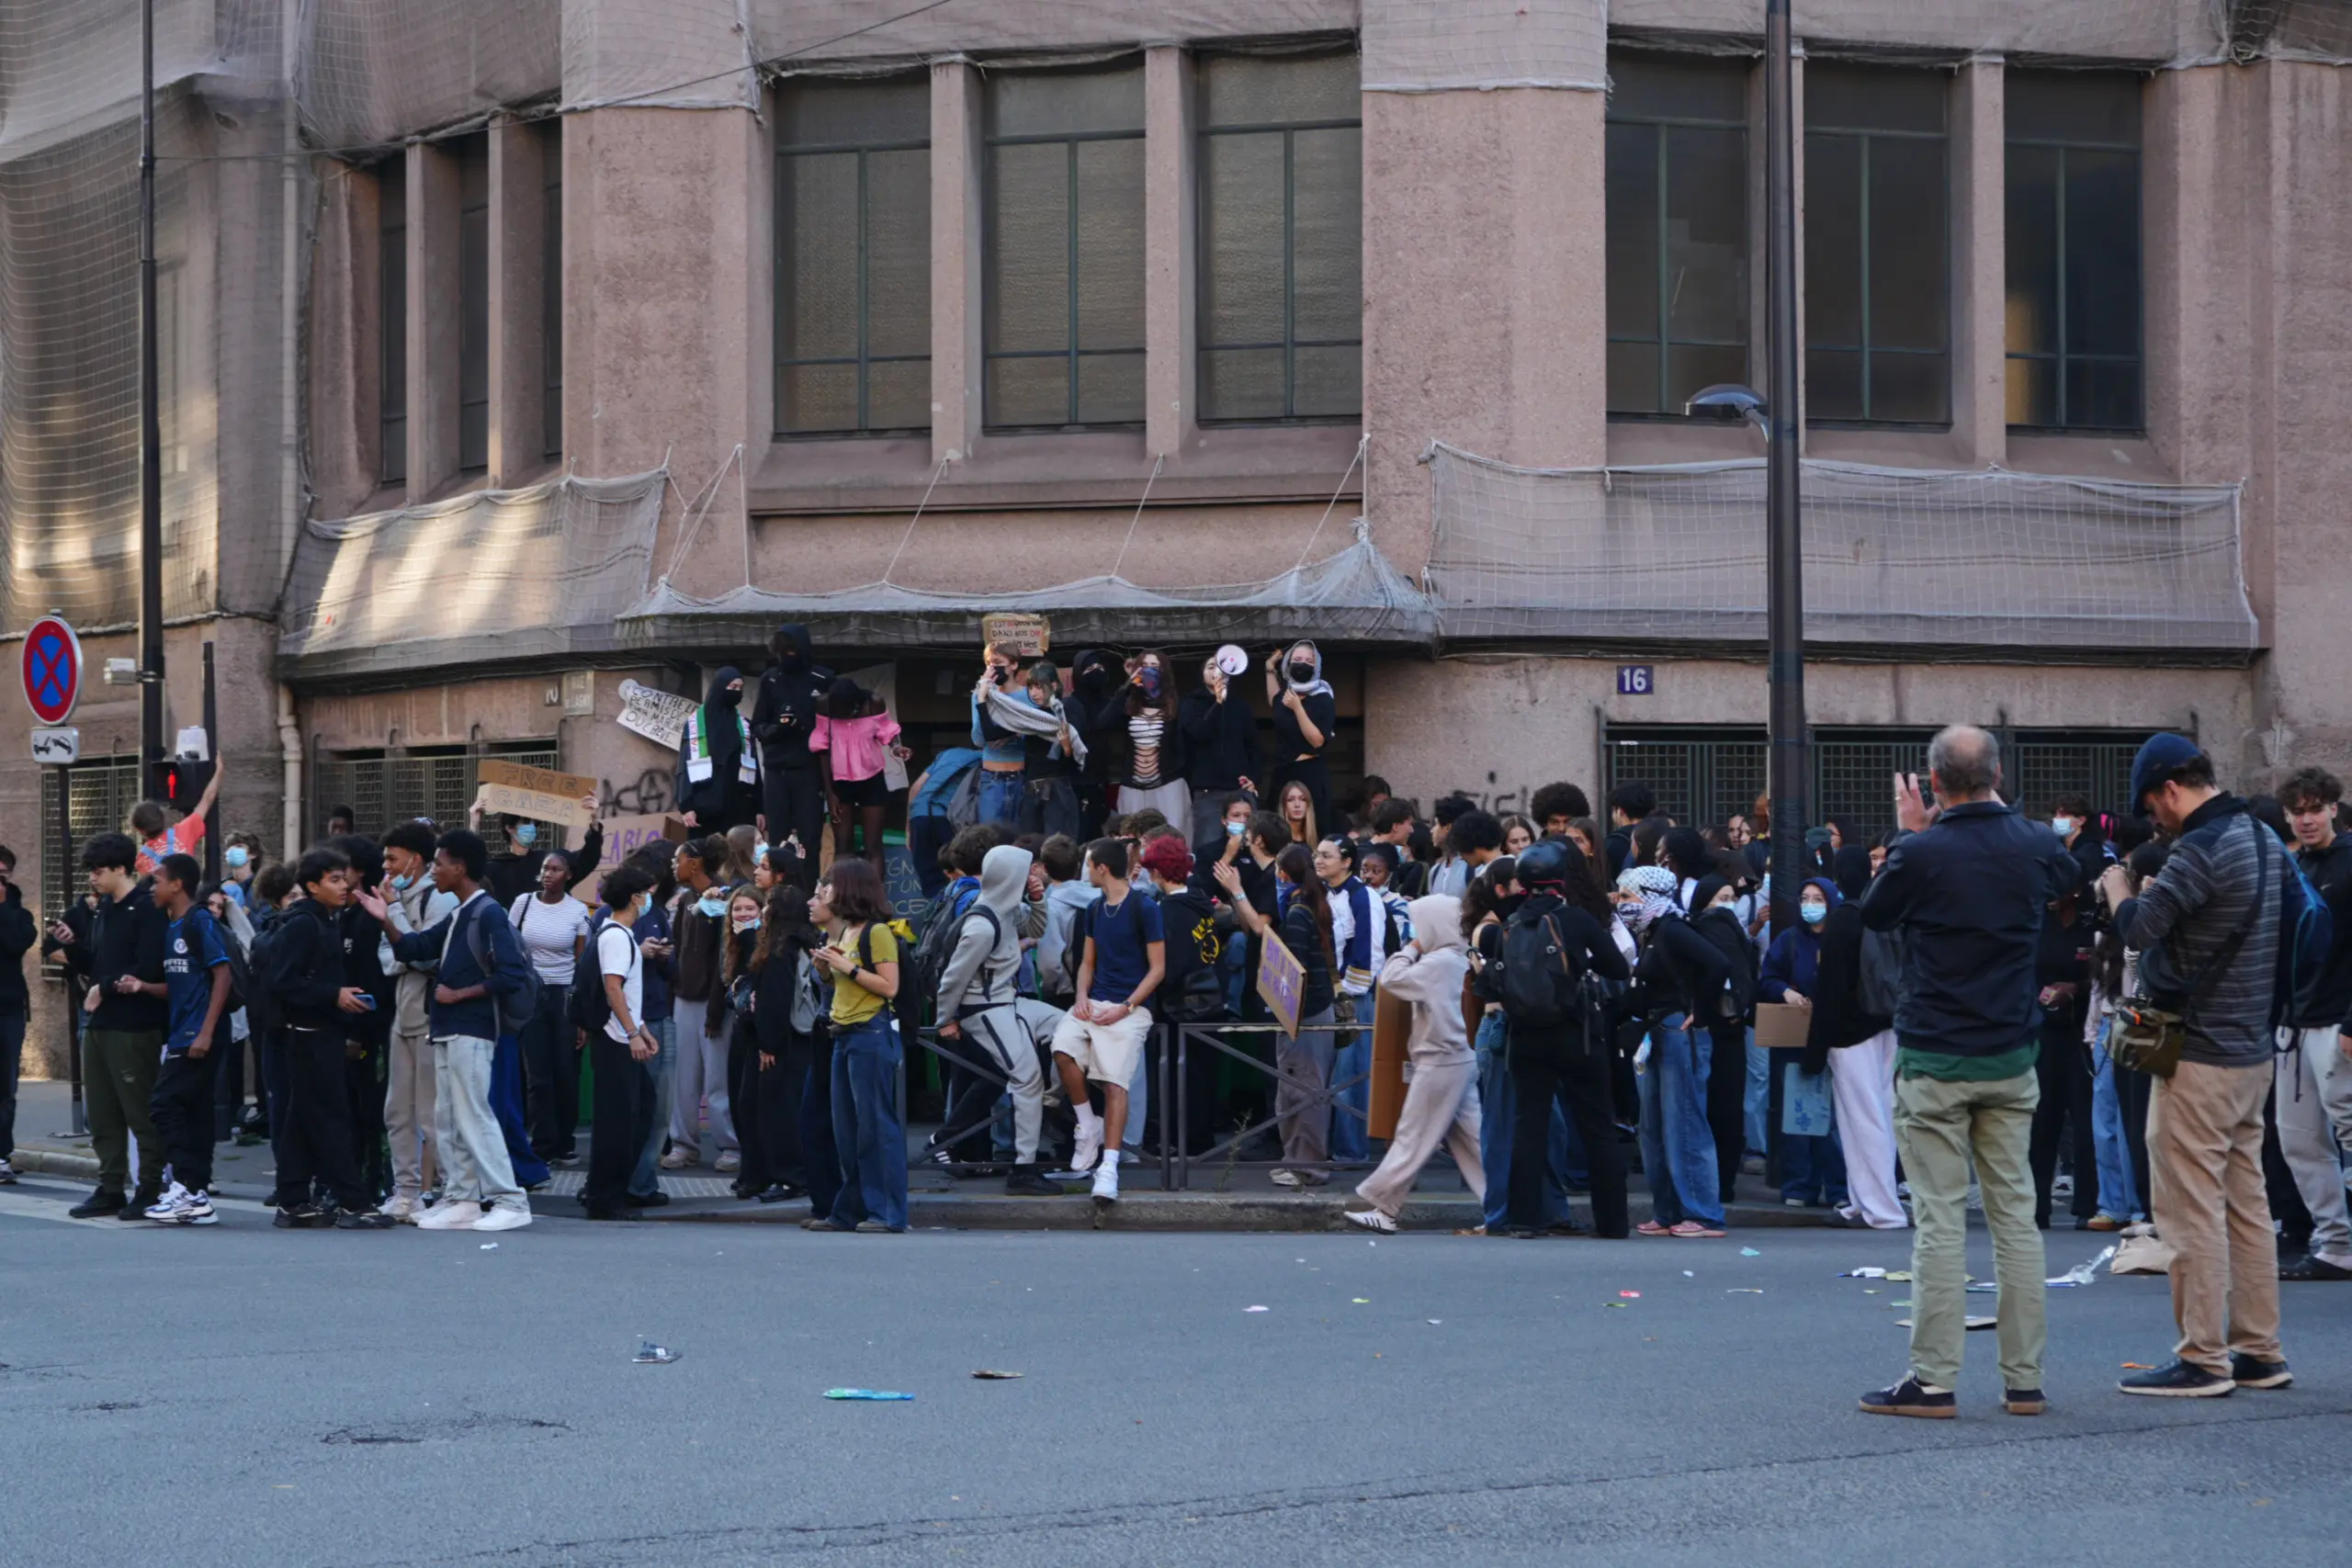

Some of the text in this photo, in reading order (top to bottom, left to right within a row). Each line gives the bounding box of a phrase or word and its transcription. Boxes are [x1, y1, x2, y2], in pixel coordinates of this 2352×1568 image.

[1623, 668, 1647, 692] 16
[629, 695, 670, 716] PERMIS
[632, 686, 684, 710] CONTRE
[501, 764, 579, 795] FREE
[492, 790, 575, 823] GAZA
